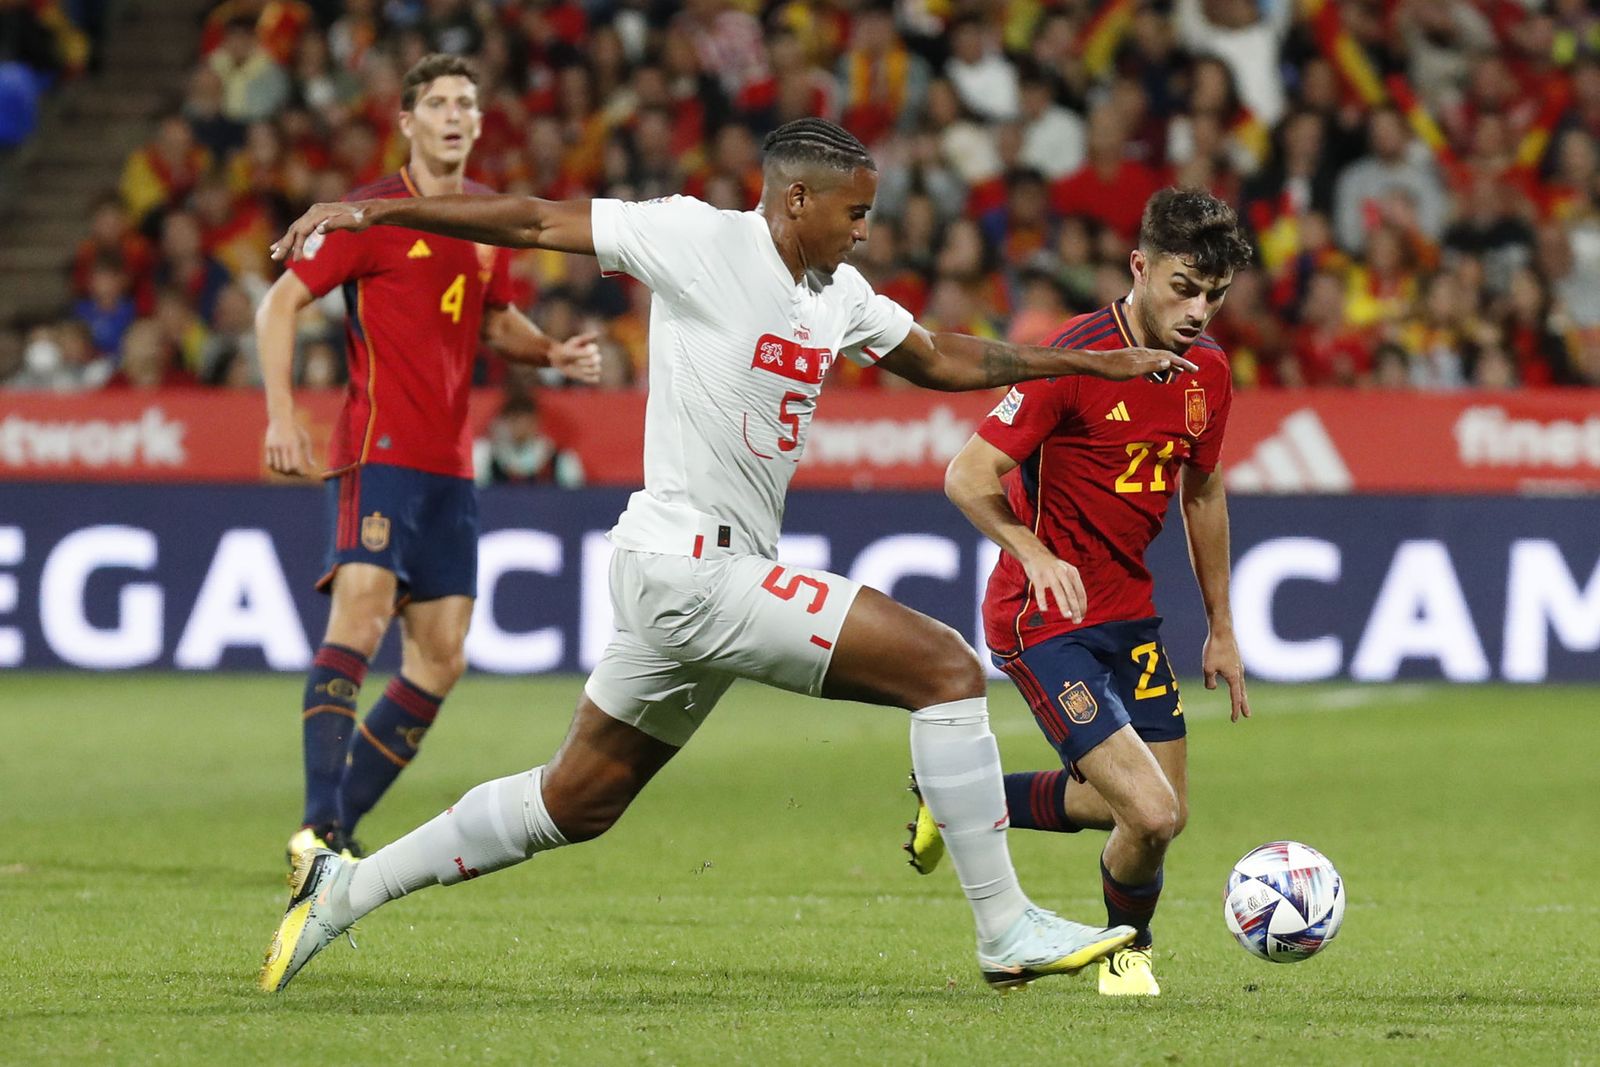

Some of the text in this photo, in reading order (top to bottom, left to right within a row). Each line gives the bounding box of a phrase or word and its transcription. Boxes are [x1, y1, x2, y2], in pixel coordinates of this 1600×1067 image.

[441, 274, 467, 323] 4
[778, 391, 808, 452] 5
[1114, 440, 1175, 494] 21
[761, 565, 830, 615] 5
[1131, 641, 1178, 700] 2
